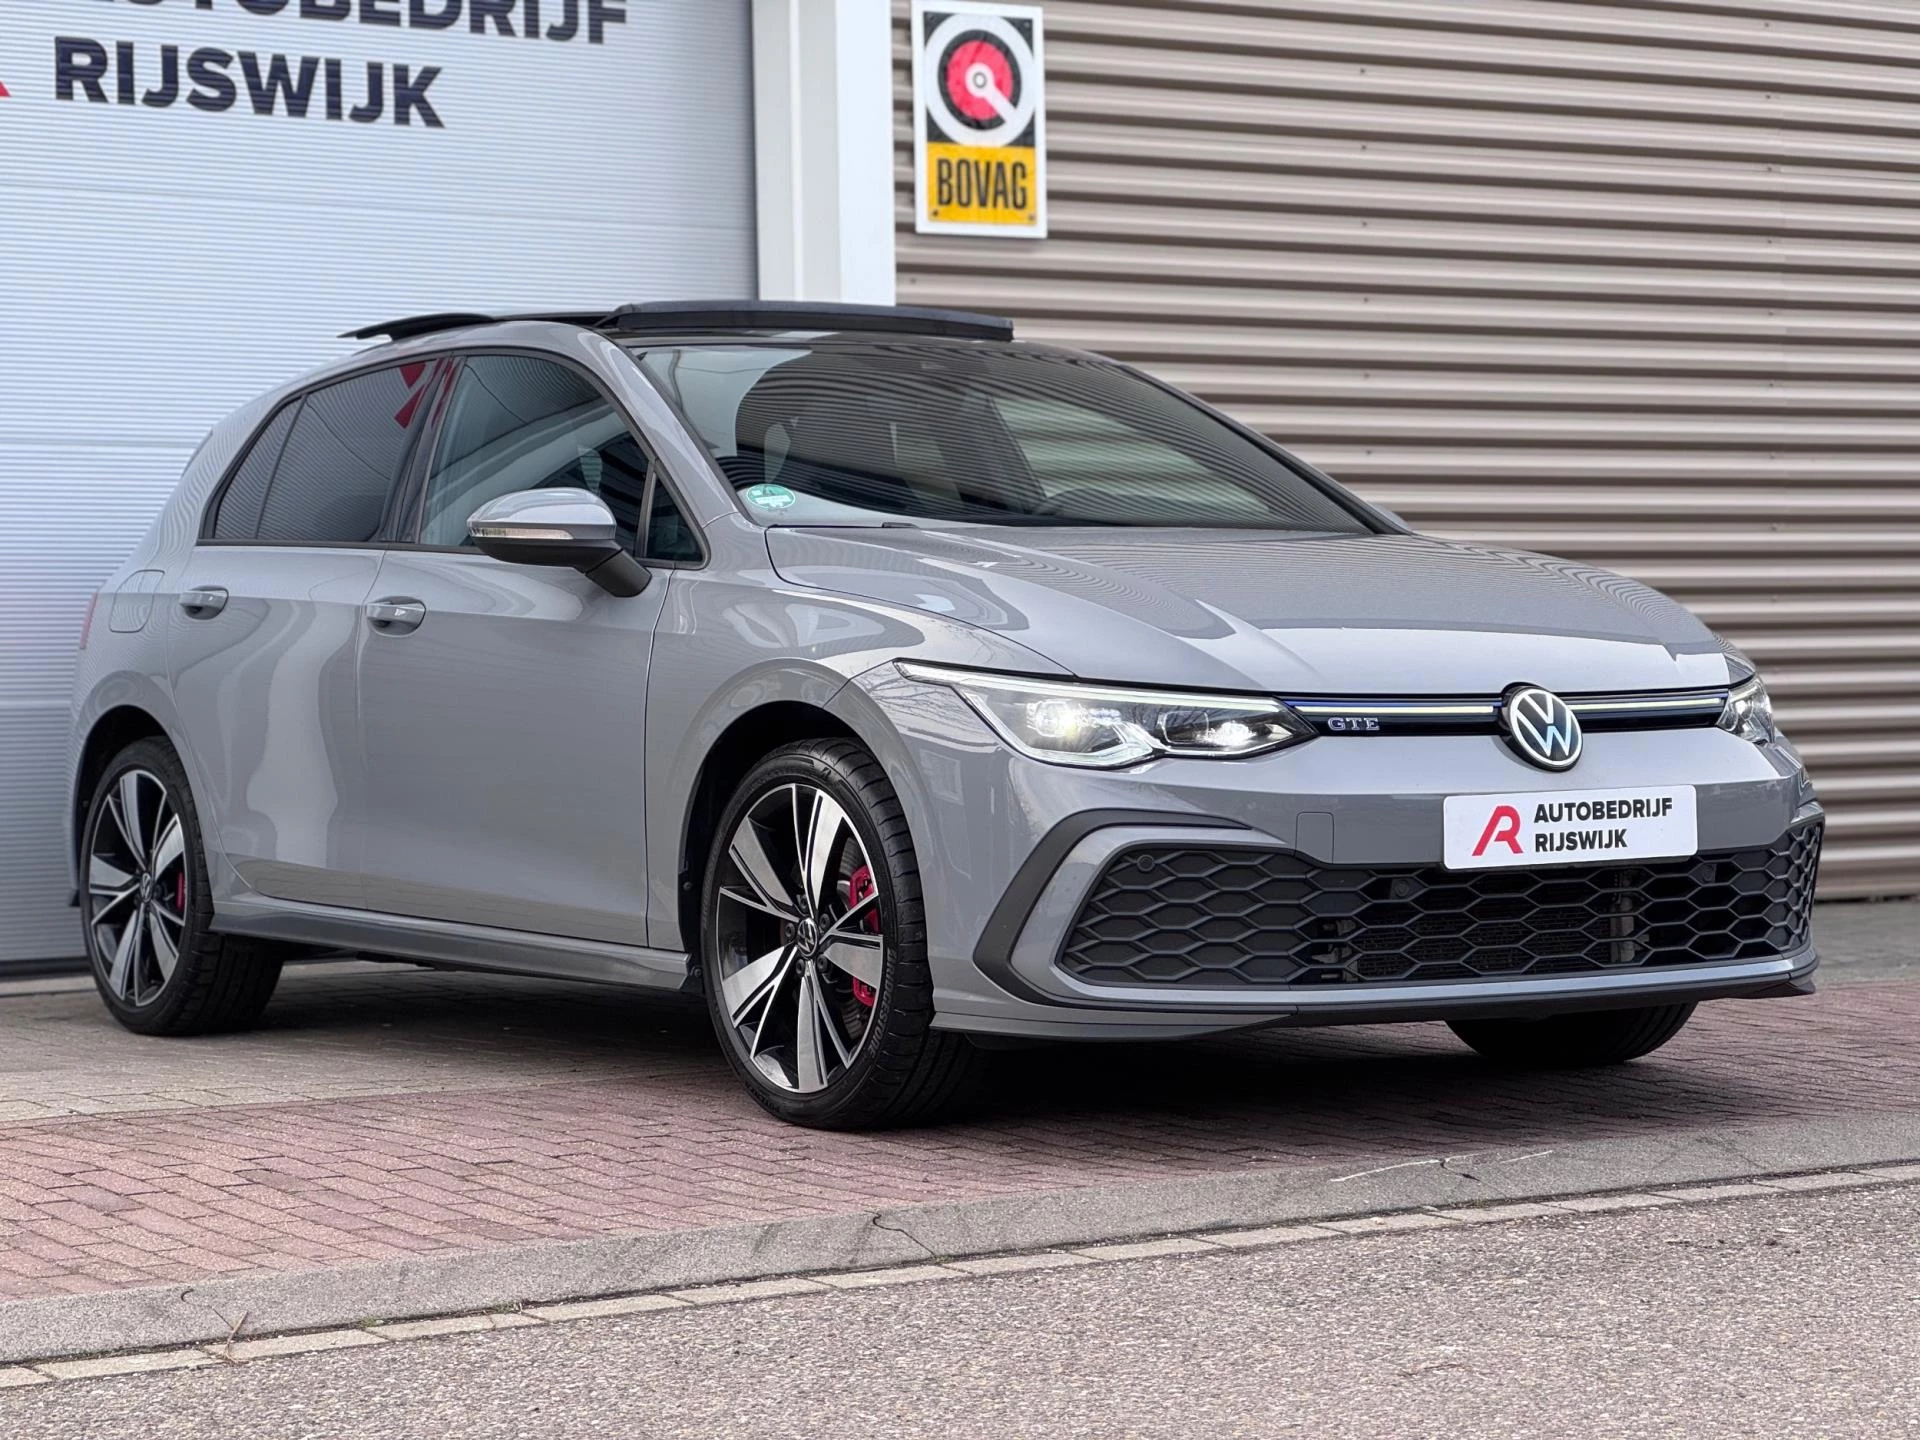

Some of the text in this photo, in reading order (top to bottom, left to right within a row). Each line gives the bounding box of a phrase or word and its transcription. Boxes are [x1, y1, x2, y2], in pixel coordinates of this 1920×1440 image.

[54, 36, 445, 128] RIJSWIJK
[937, 158, 1027, 210] BOVAG
[1328, 717, 1380, 731] GTE
[1534, 797, 1673, 823] AUTOBEDRIJF
[1535, 829, 1628, 852] RIJSWIJK
